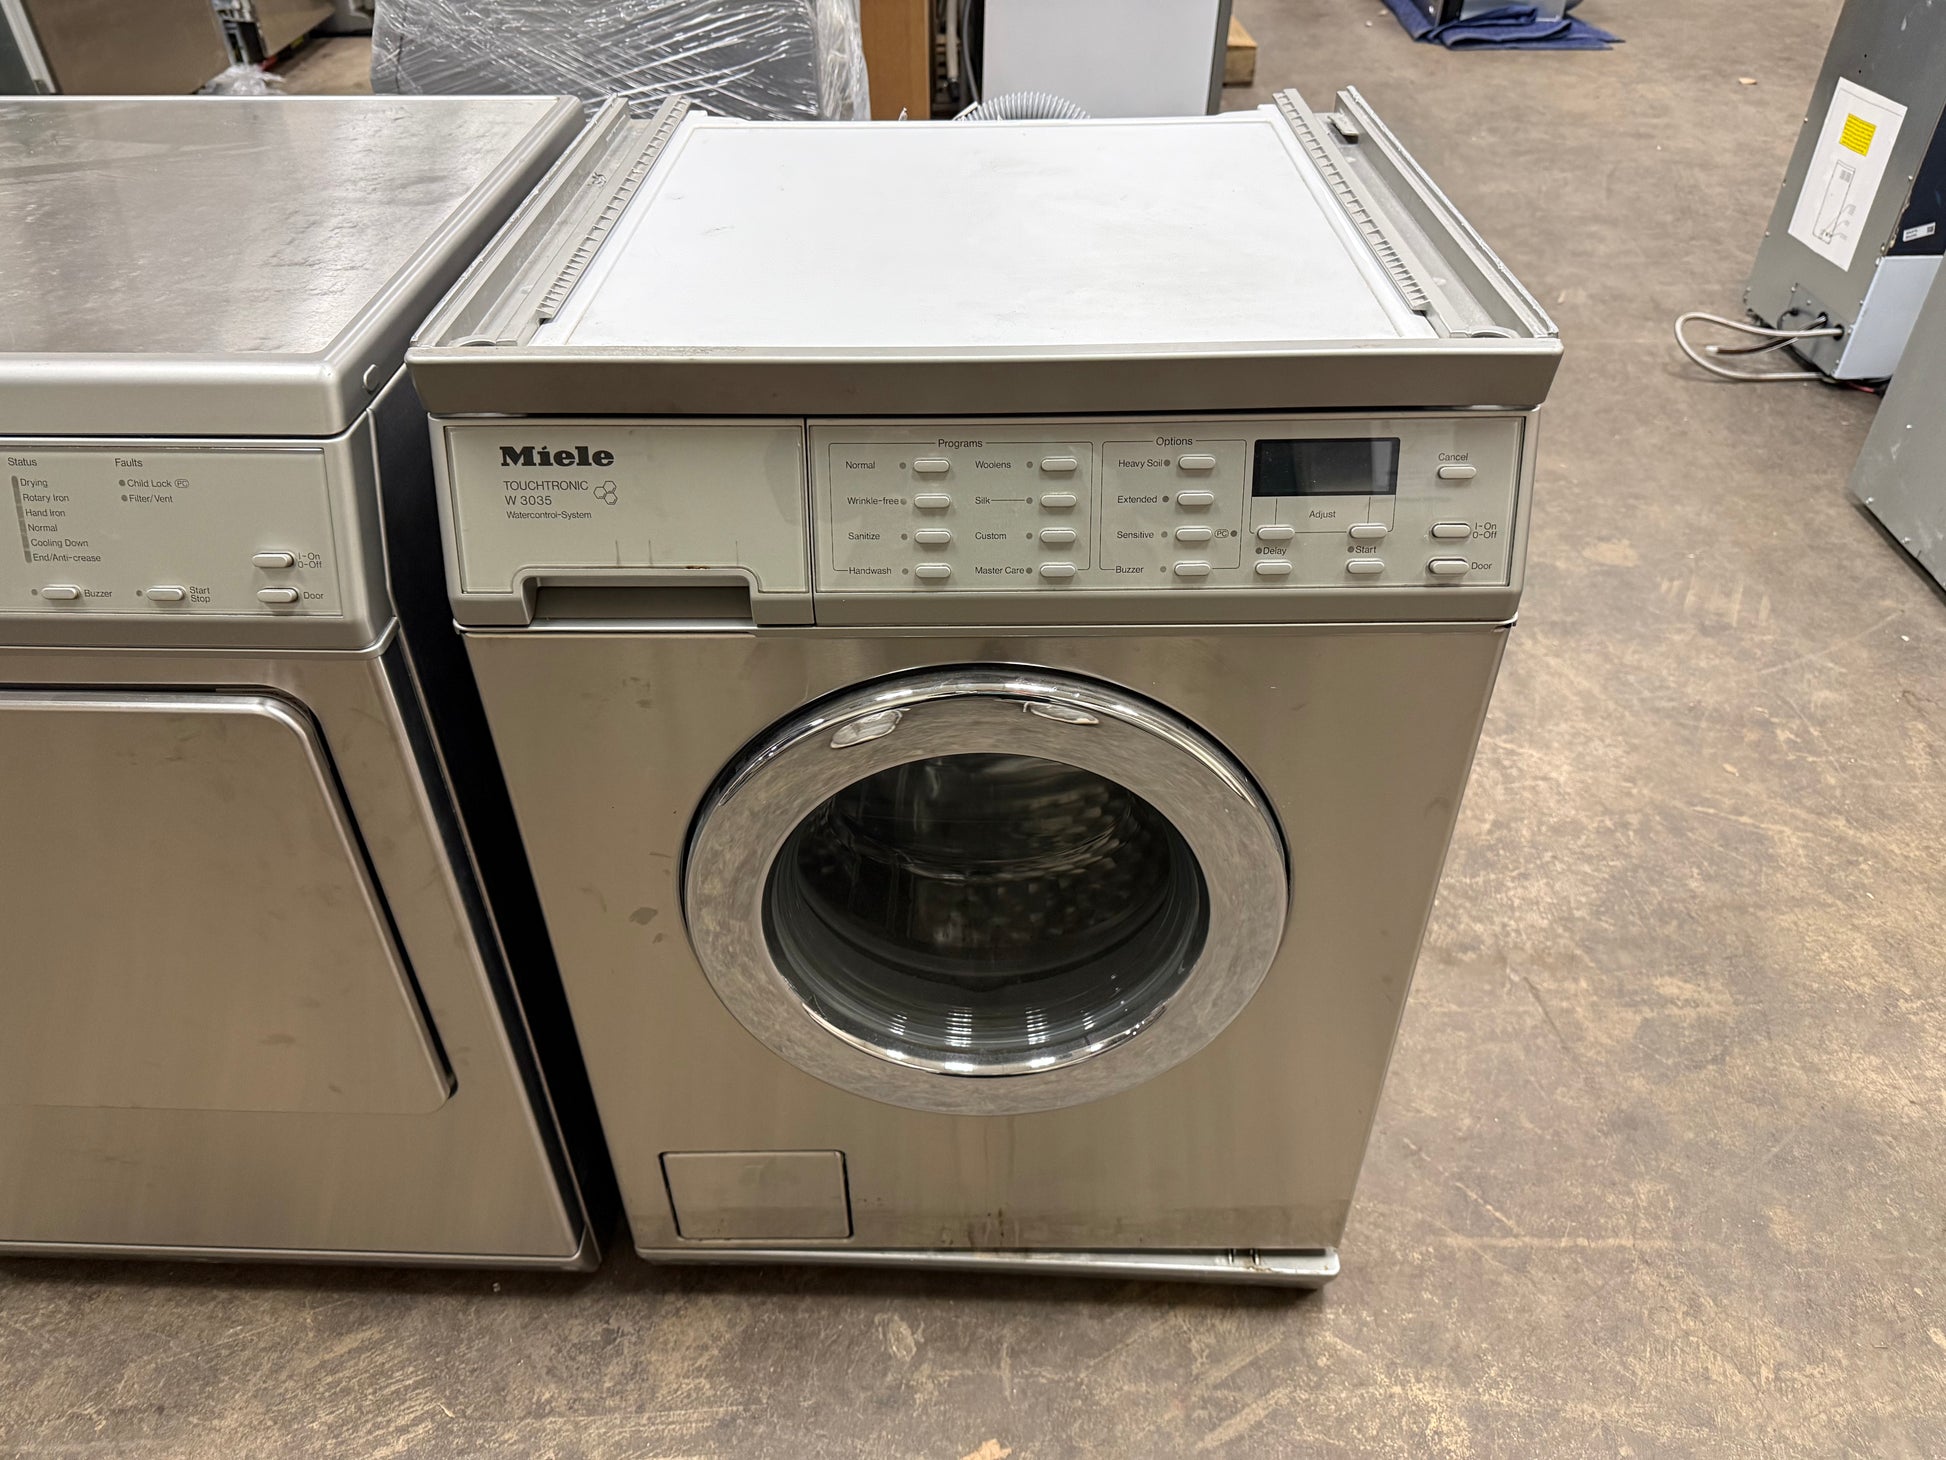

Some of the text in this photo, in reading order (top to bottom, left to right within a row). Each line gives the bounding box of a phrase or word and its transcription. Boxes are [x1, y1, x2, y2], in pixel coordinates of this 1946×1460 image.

[938, 439, 983, 449] Programs
[1156, 436, 1193, 447] Options
[499, 445, 615, 467] Miele
[1438, 453, 1469, 461] Cancel
[7, 456, 37, 467] Status
[115, 458, 143, 468] Faults
[845, 461, 876, 469] Normal
[975, 461, 1012, 469] Woolens
[1118, 459, 1163, 468] Heavy Soil
[20, 478, 48, 490] Drying
[127, 479, 149, 488] Child
[151, 479, 172, 488] Lock
[503, 480, 589, 491] TOUCHTRONIC
[22, 492, 69, 504] Rotary Iron
[129, 494, 173, 503] Filter/Vent
[504, 495, 552, 506] W 3035
[847, 497, 899, 505] Wrinkle-free
[975, 497, 990, 505] Silk
[25, 508, 66, 518] Hand Iron
[506, 510, 592, 520] Watercontrol-System
[1308, 510, 1336, 519] Adjust
[28, 523, 58, 532] Normal
[848, 532, 880, 541] Sanitize
[975, 532, 1007, 540] Custom
[1116, 531, 1154, 539] Sensitive
[30, 538, 89, 549] Cooling Down
[1263, 547, 1287, 555] Delay
[1355, 546, 1377, 554] Start
[33, 553, 101, 562] End/Anti-crease
[848, 566, 892, 575] Handwash
[975, 566, 1025, 575] Master Care
[1115, 566, 1144, 574] Buzzer
[1471, 562, 1492, 570] Door
[84, 589, 113, 598] Buzzer
[190, 586, 210, 595] Start
[190, 594, 211, 604] Stop
[303, 591, 324, 600] Door
